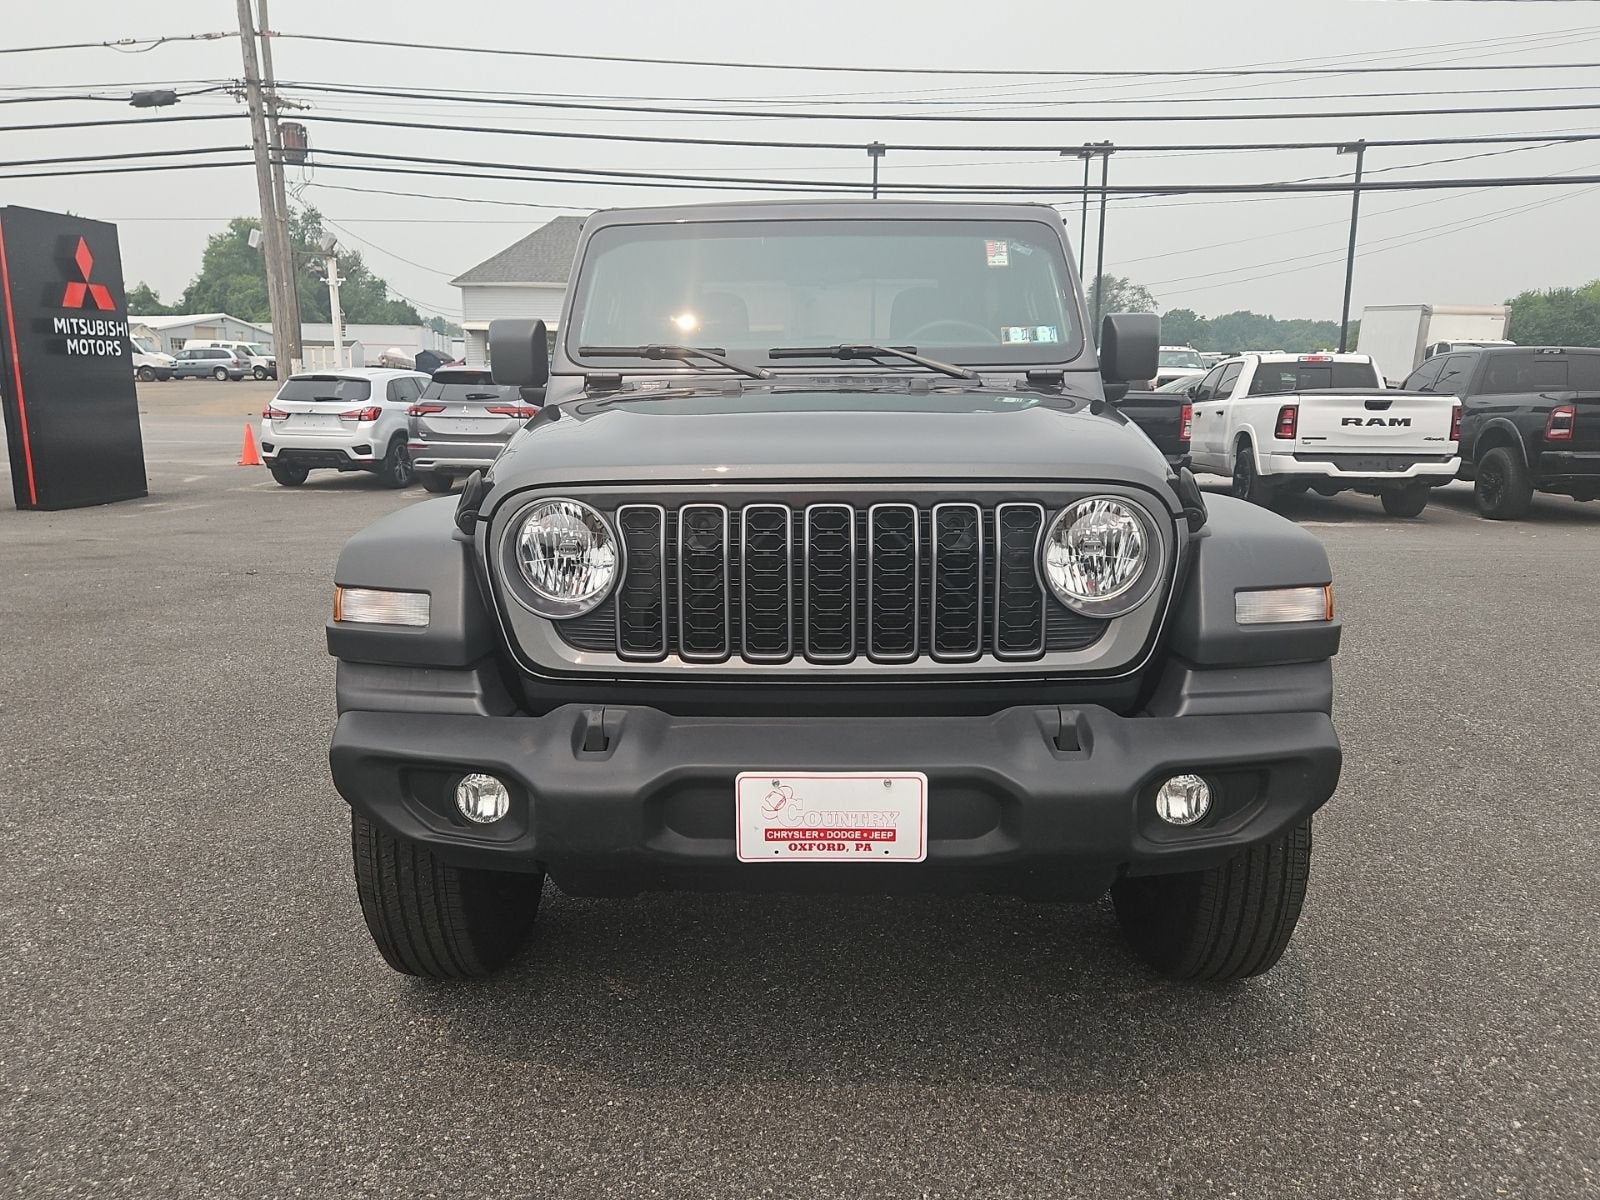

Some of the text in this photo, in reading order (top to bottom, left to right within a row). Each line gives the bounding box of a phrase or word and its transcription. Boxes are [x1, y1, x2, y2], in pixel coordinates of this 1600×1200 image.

[53, 317, 129, 337] MITSUBISHI
[66, 339, 122, 356] MOTORS
[1341, 417, 1412, 427] RAM
[766, 830, 894, 839] CHRYSLER DODGE JEEP
[788, 842, 873, 853] OXFORD, PA
